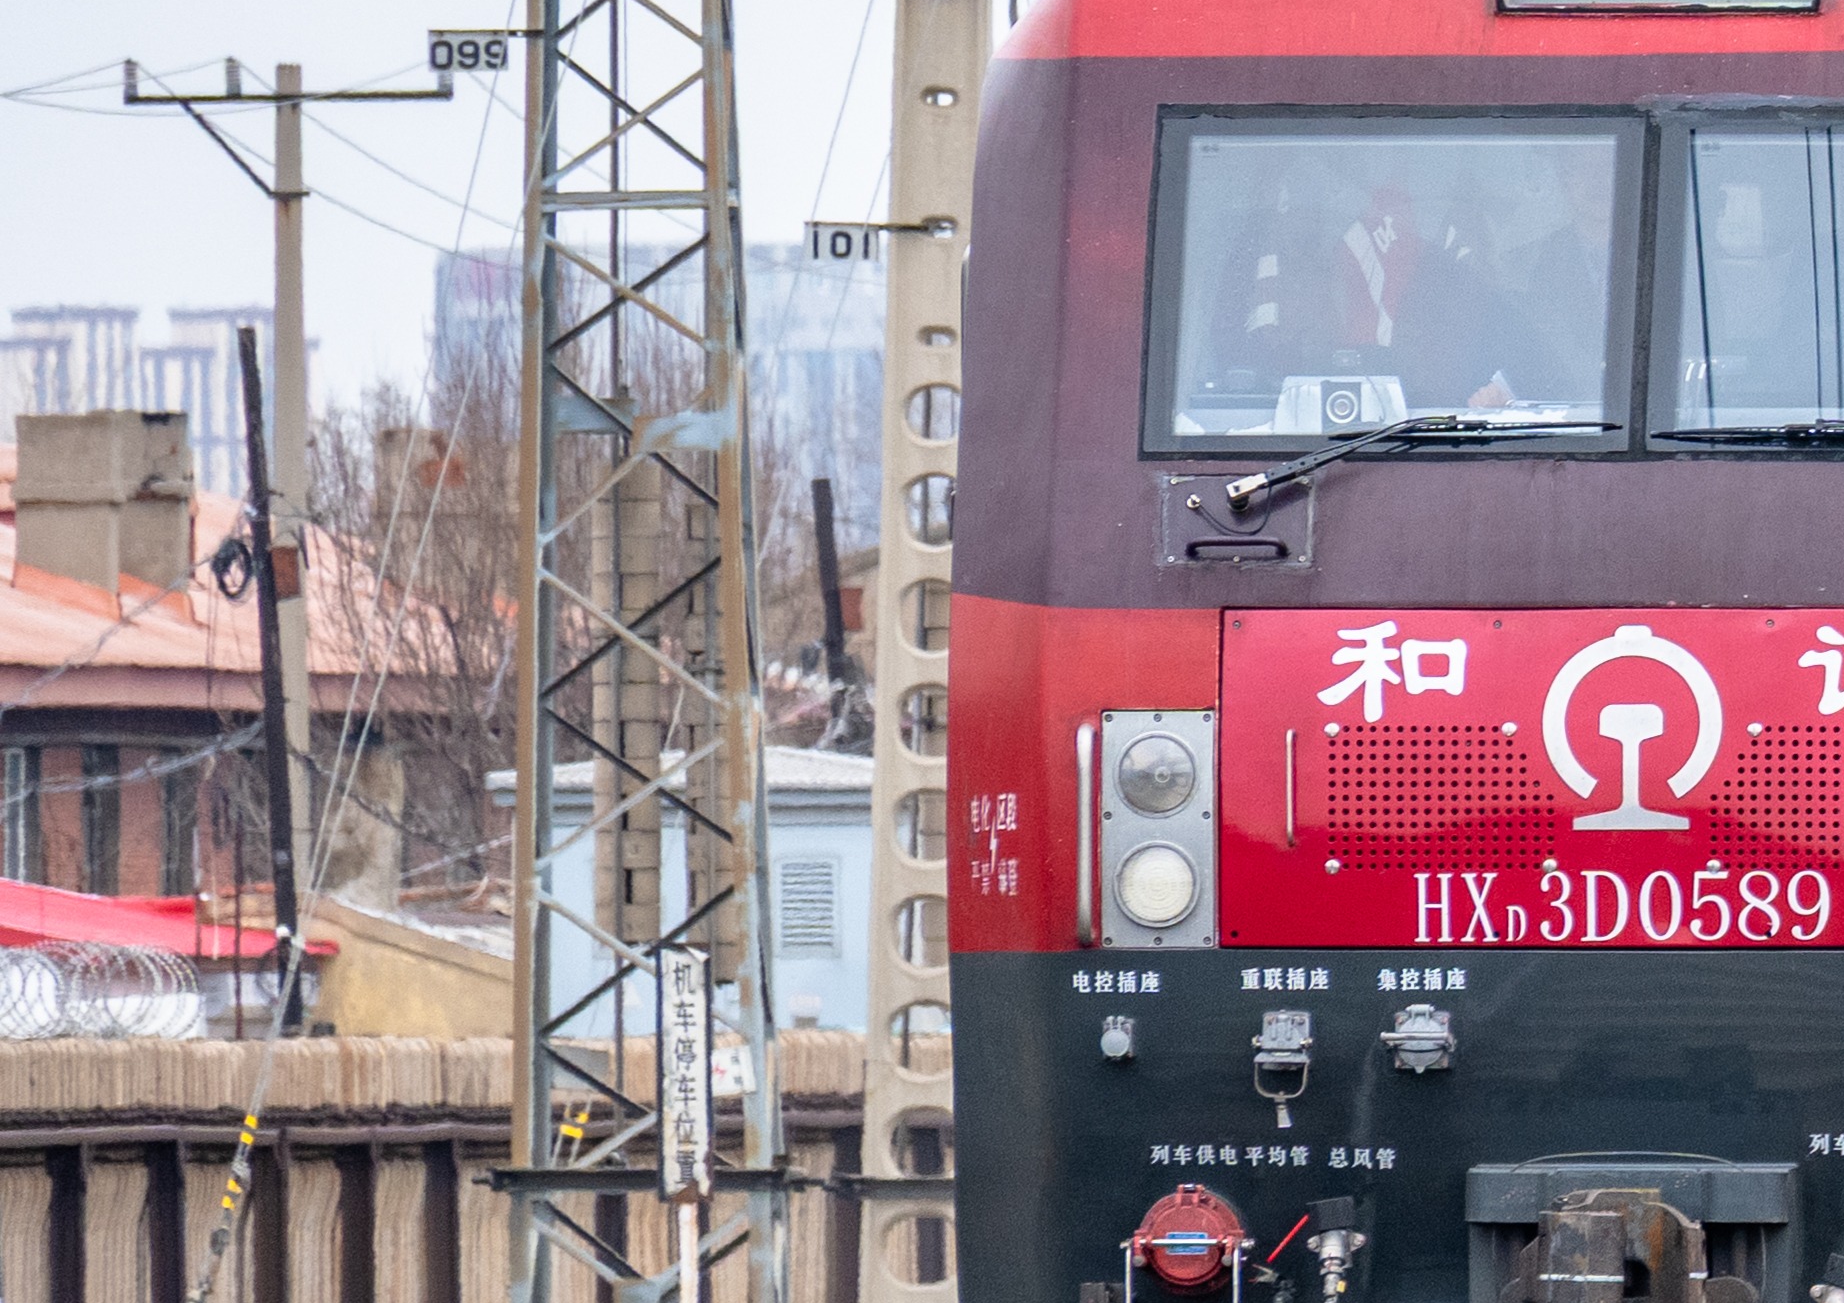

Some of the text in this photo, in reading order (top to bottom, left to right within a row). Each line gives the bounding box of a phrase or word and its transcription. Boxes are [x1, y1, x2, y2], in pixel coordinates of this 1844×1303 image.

[430, 39, 508, 71] 099
[812, 229, 869, 260] 101
[1316, 620, 1468, 723] 和
[1072, 970, 1161, 994] 电控插座
[1240, 968, 1331, 991] 重联插座
[1377, 968, 1467, 991] 集控插座
[672, 959, 698, 1185] 机车停车位置
[1149, 1144, 1396, 1170] 列车供电 平均管 总风管
